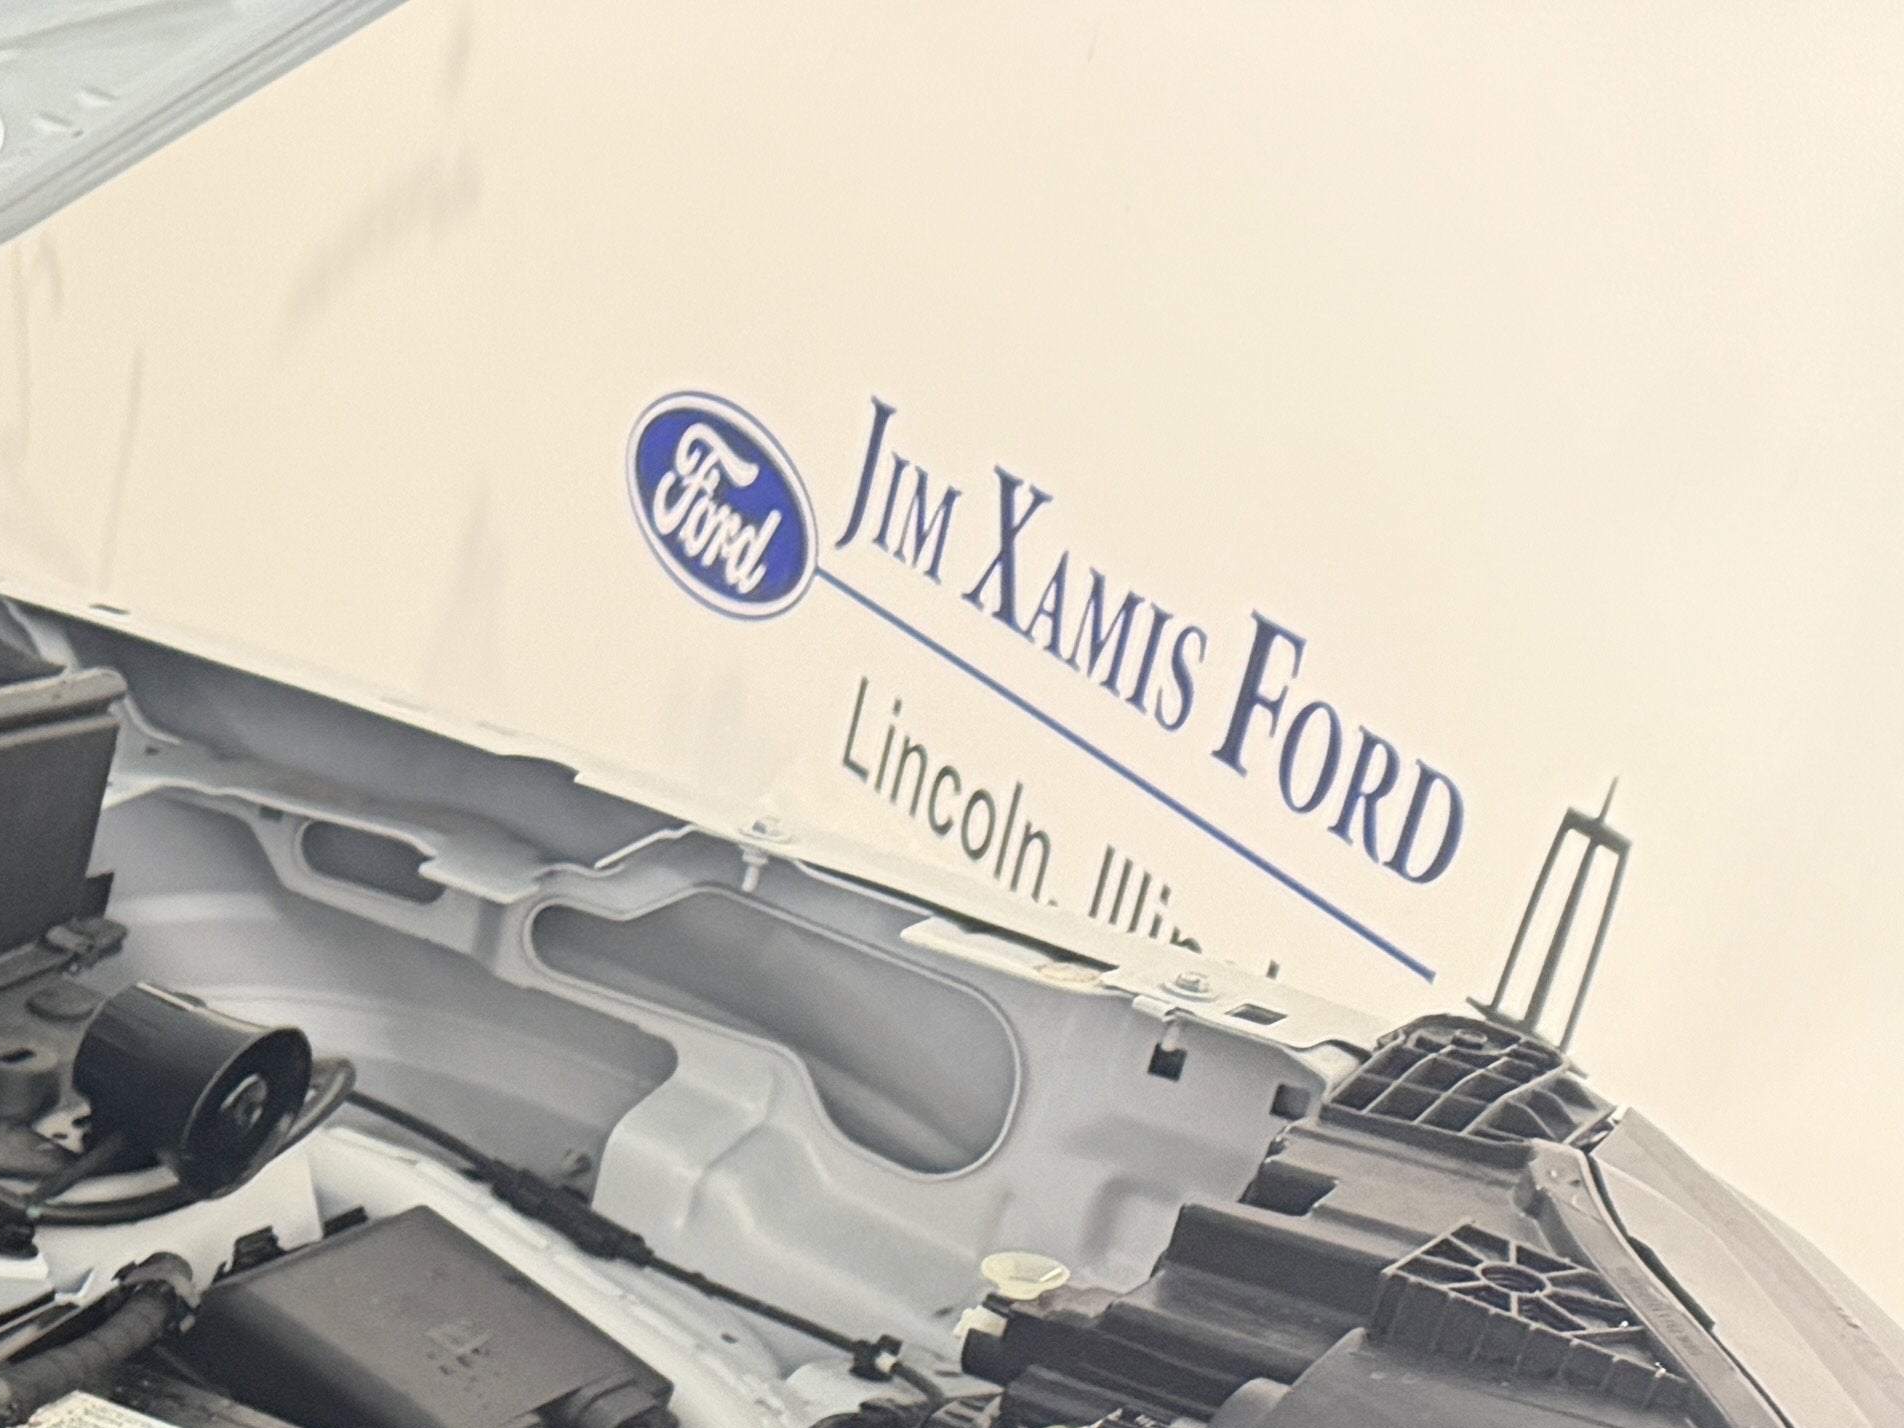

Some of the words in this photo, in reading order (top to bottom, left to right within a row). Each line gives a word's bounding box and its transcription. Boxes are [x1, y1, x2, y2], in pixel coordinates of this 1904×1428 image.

[649, 420, 784, 595] Ford
[835, 395, 962, 585] JIM
[961, 465, 1208, 732] XAMIS
[1211, 609, 1465, 885] FORD
